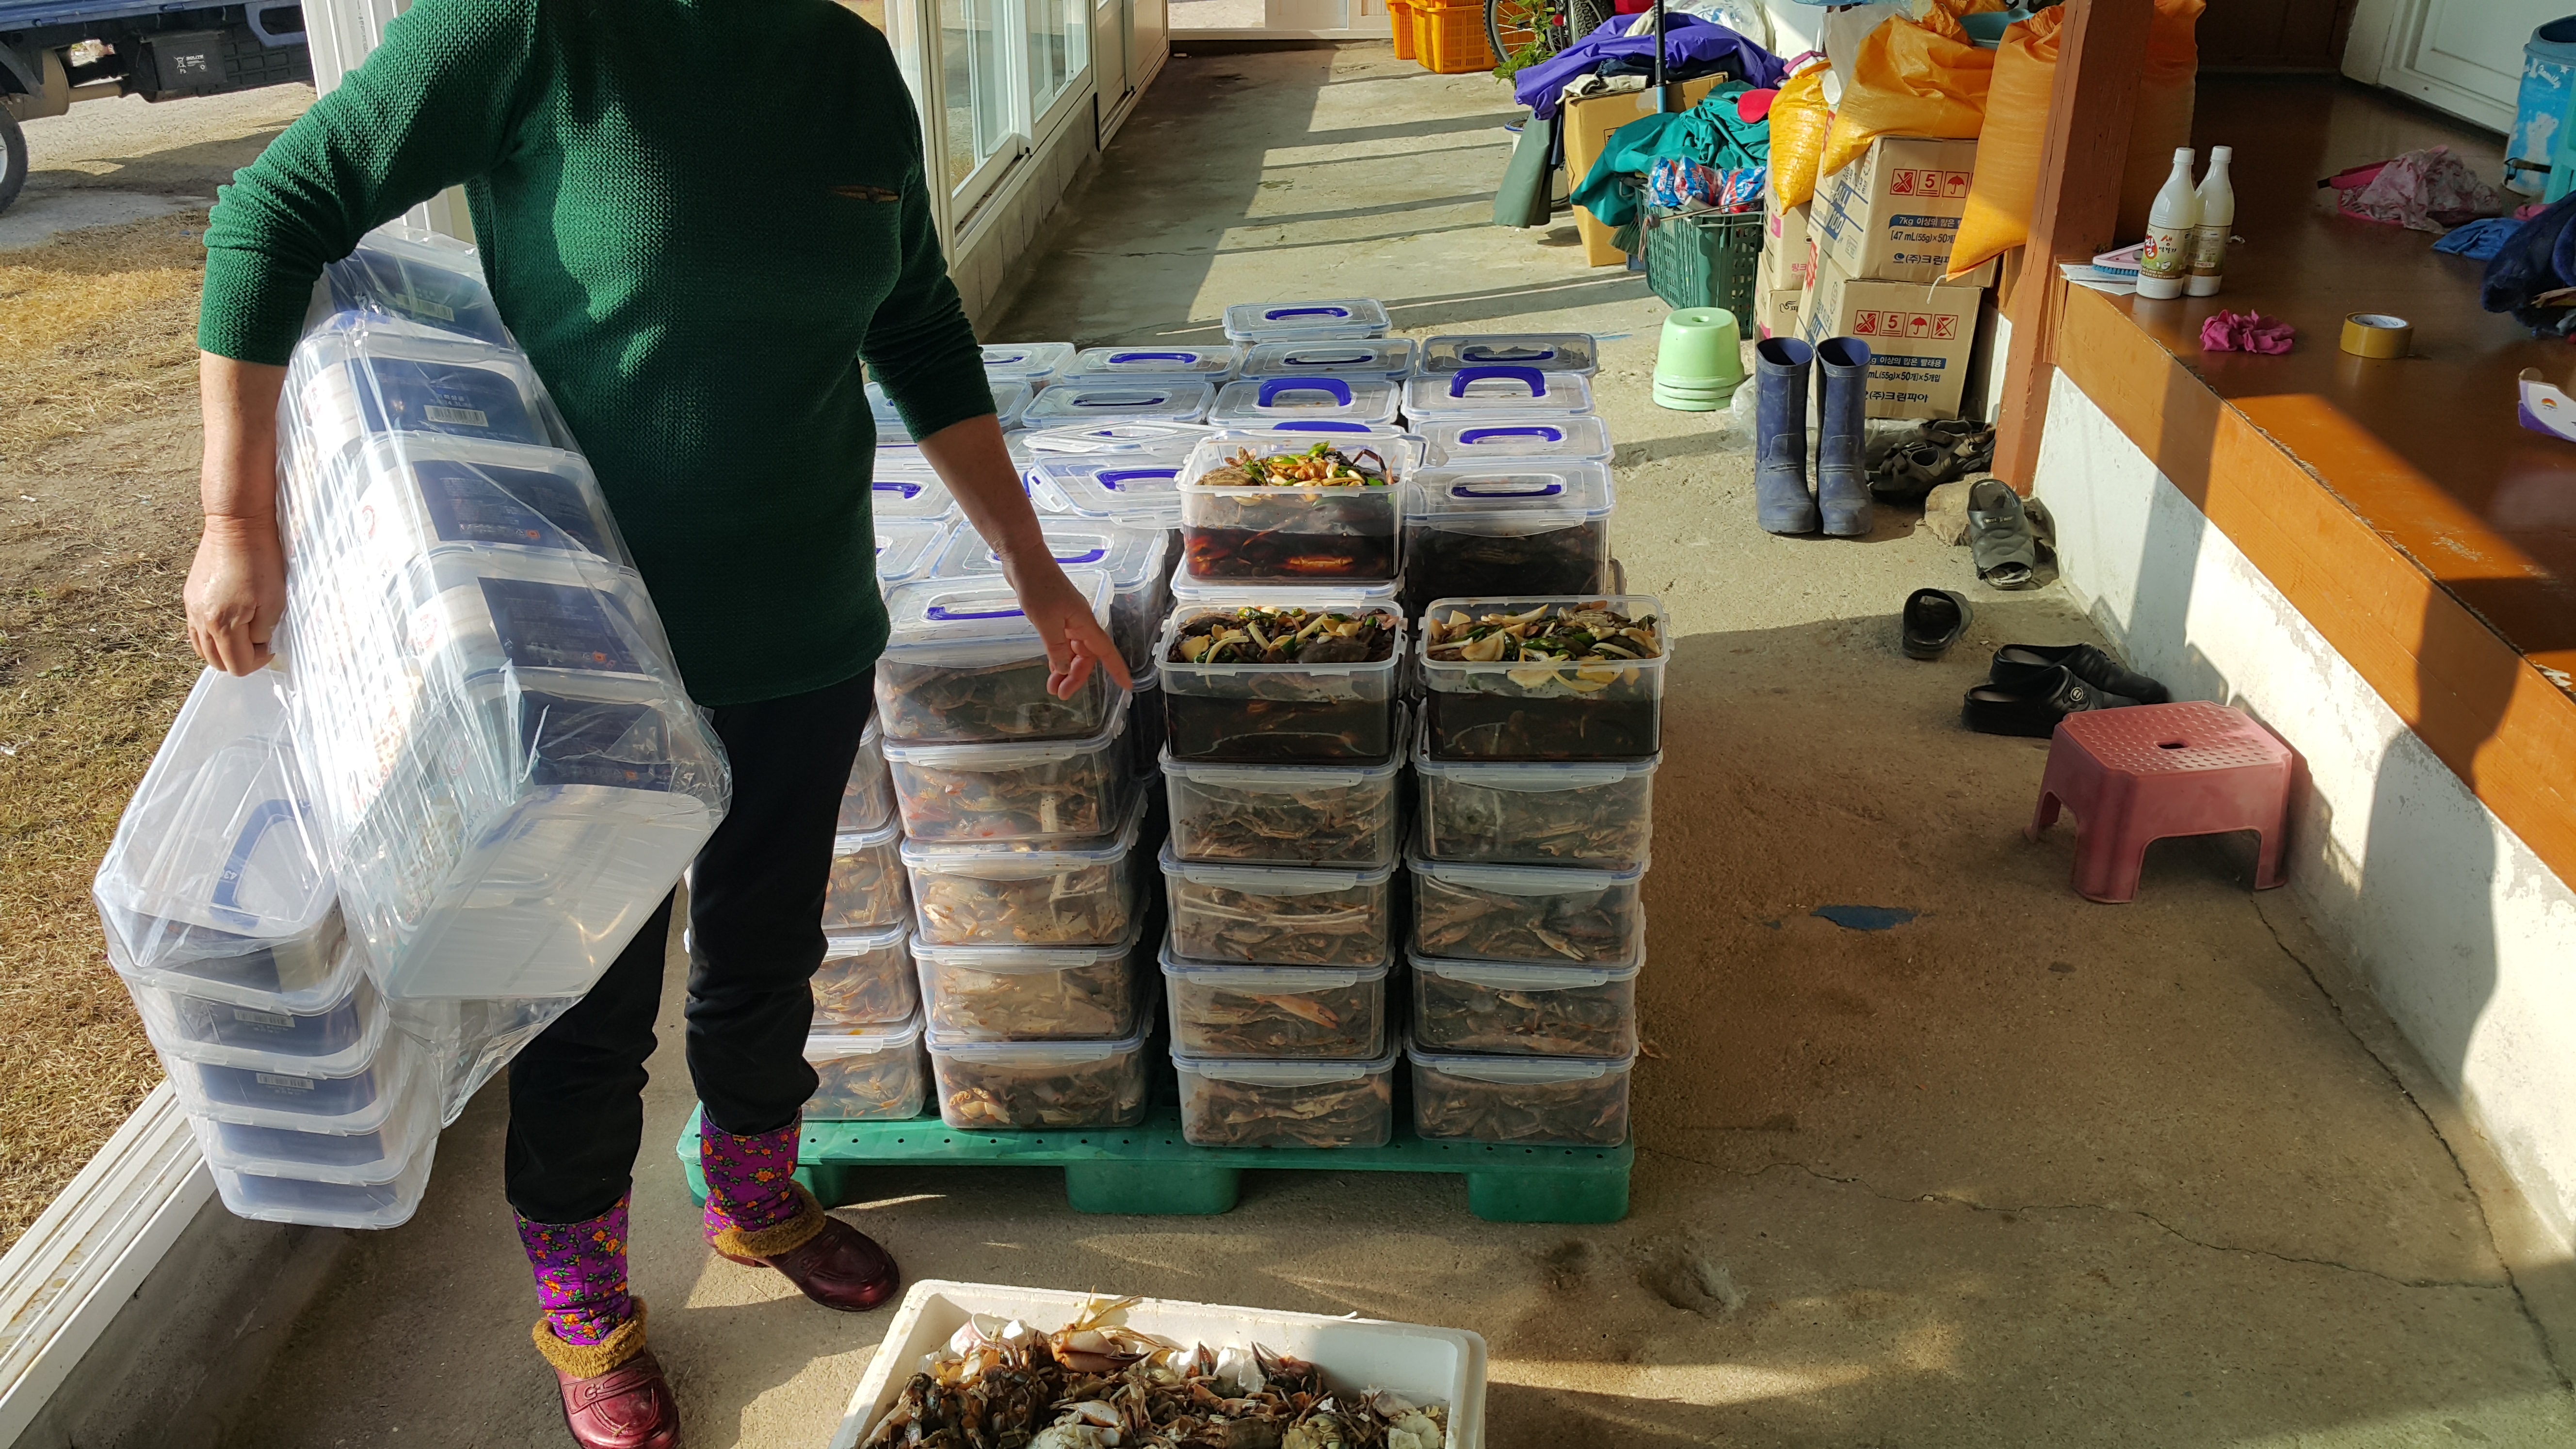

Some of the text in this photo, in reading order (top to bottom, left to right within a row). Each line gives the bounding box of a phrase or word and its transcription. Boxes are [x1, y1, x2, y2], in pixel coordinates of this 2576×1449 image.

[1925, 174, 1935, 188] 5
[1834, 185, 1849, 208] ALL
[1829, 210, 1844, 234] 100
[1899, 217, 1914, 226] 7kg
[1916, 217, 1938, 227] 이상의
[1941, 218, 1955, 228] 많은
[1887, 315, 1898, 329] 5
[1880, 356, 1901, 365] 이상의
[1904, 357, 1918, 366] 많은
[1921, 359, 1942, 367] 빨래용
